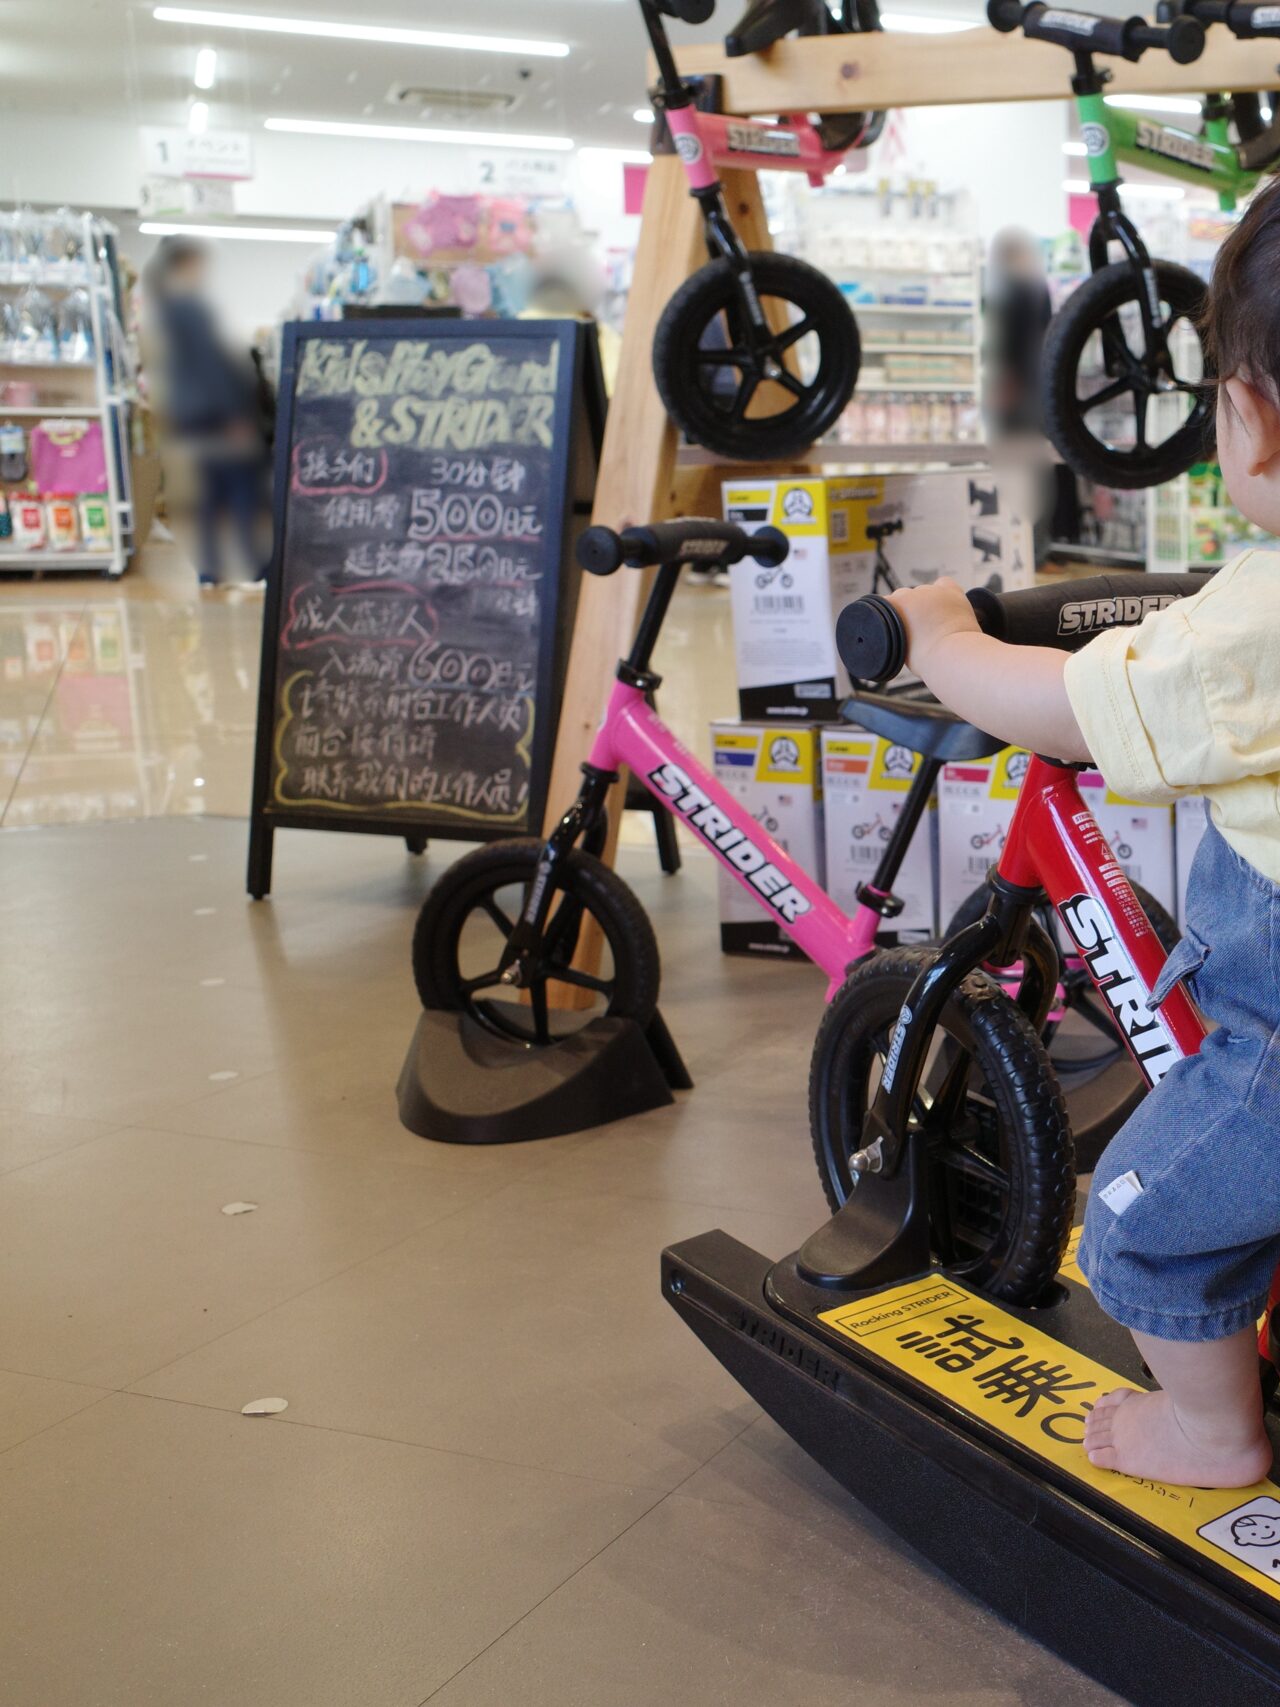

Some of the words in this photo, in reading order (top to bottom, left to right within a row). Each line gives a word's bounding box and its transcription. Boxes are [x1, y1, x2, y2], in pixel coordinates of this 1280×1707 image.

[648, 763, 812, 924] STRIDER
[881, 1023, 907, 1094] STRIDER
[849, 1308, 904, 1331] Rocking
[901, 1290, 952, 1314] STRIDER
